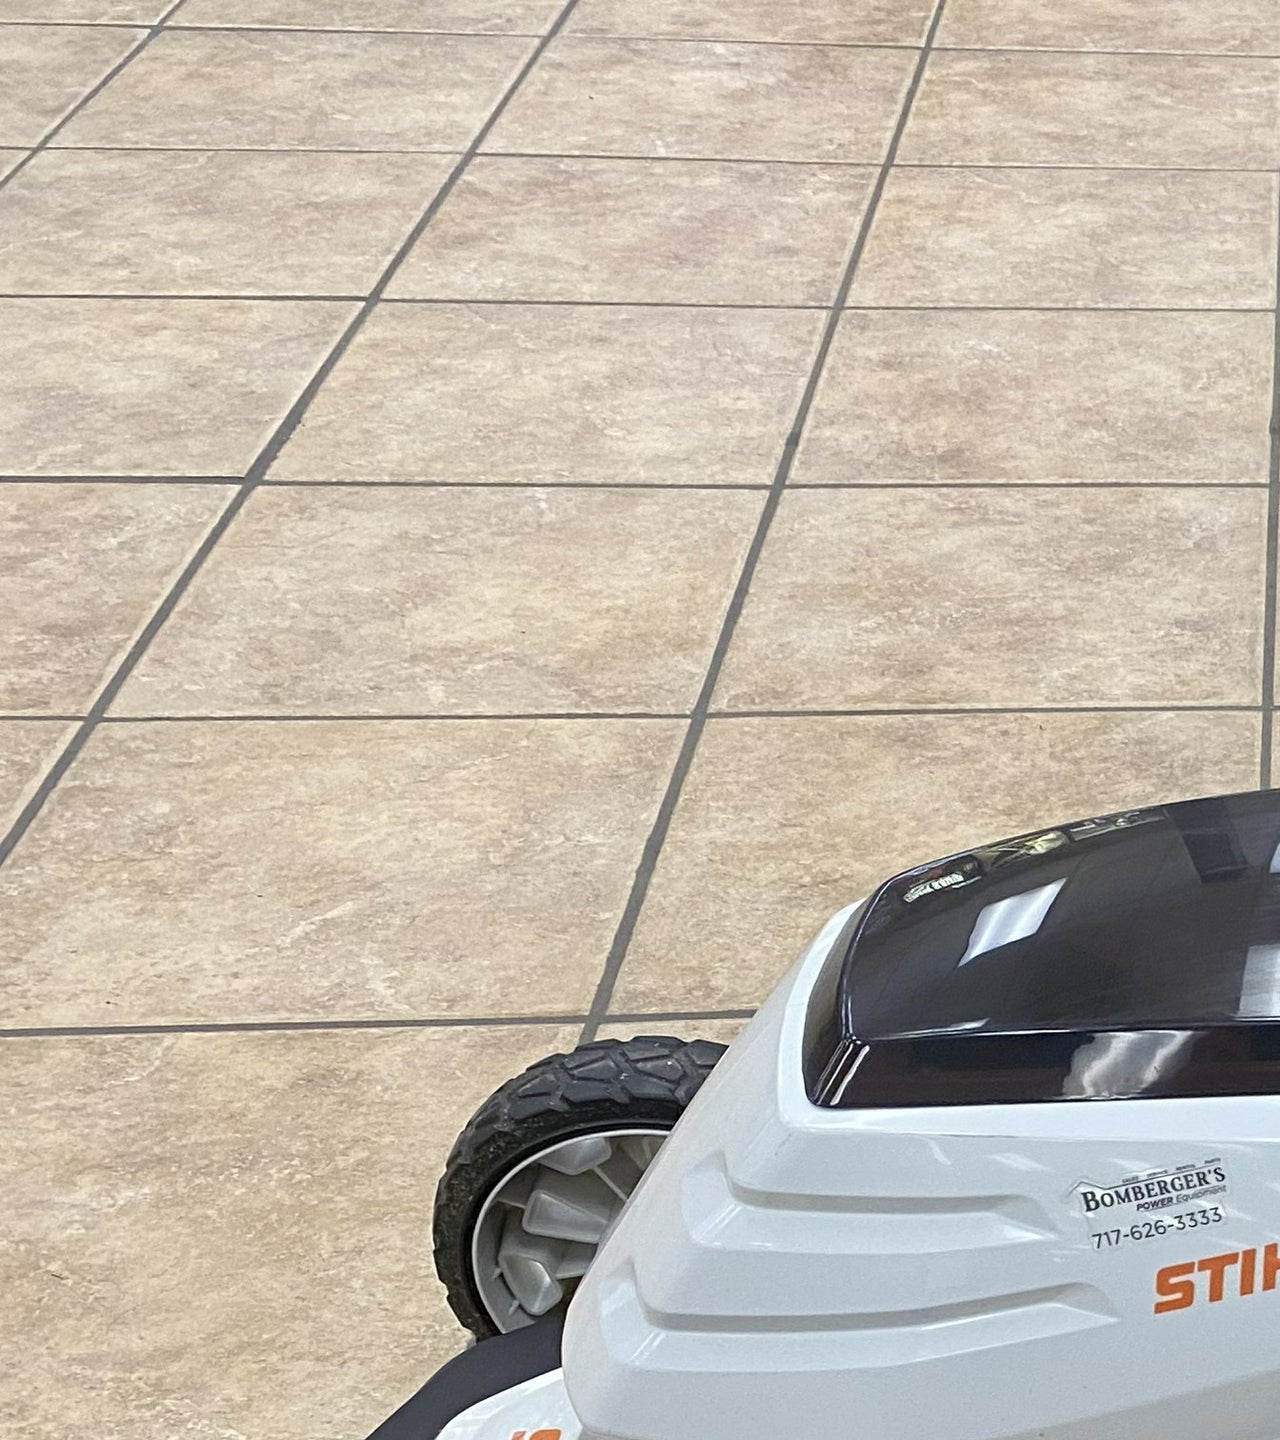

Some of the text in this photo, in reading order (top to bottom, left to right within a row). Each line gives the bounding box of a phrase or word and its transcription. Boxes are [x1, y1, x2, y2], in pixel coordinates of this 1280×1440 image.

[1081, 1167, 1225, 1212] BOMBERGER'S
[1136, 1185, 1226, 1211] POWER Equipment
[1092, 1207, 1222, 1249] 717-626-3333
